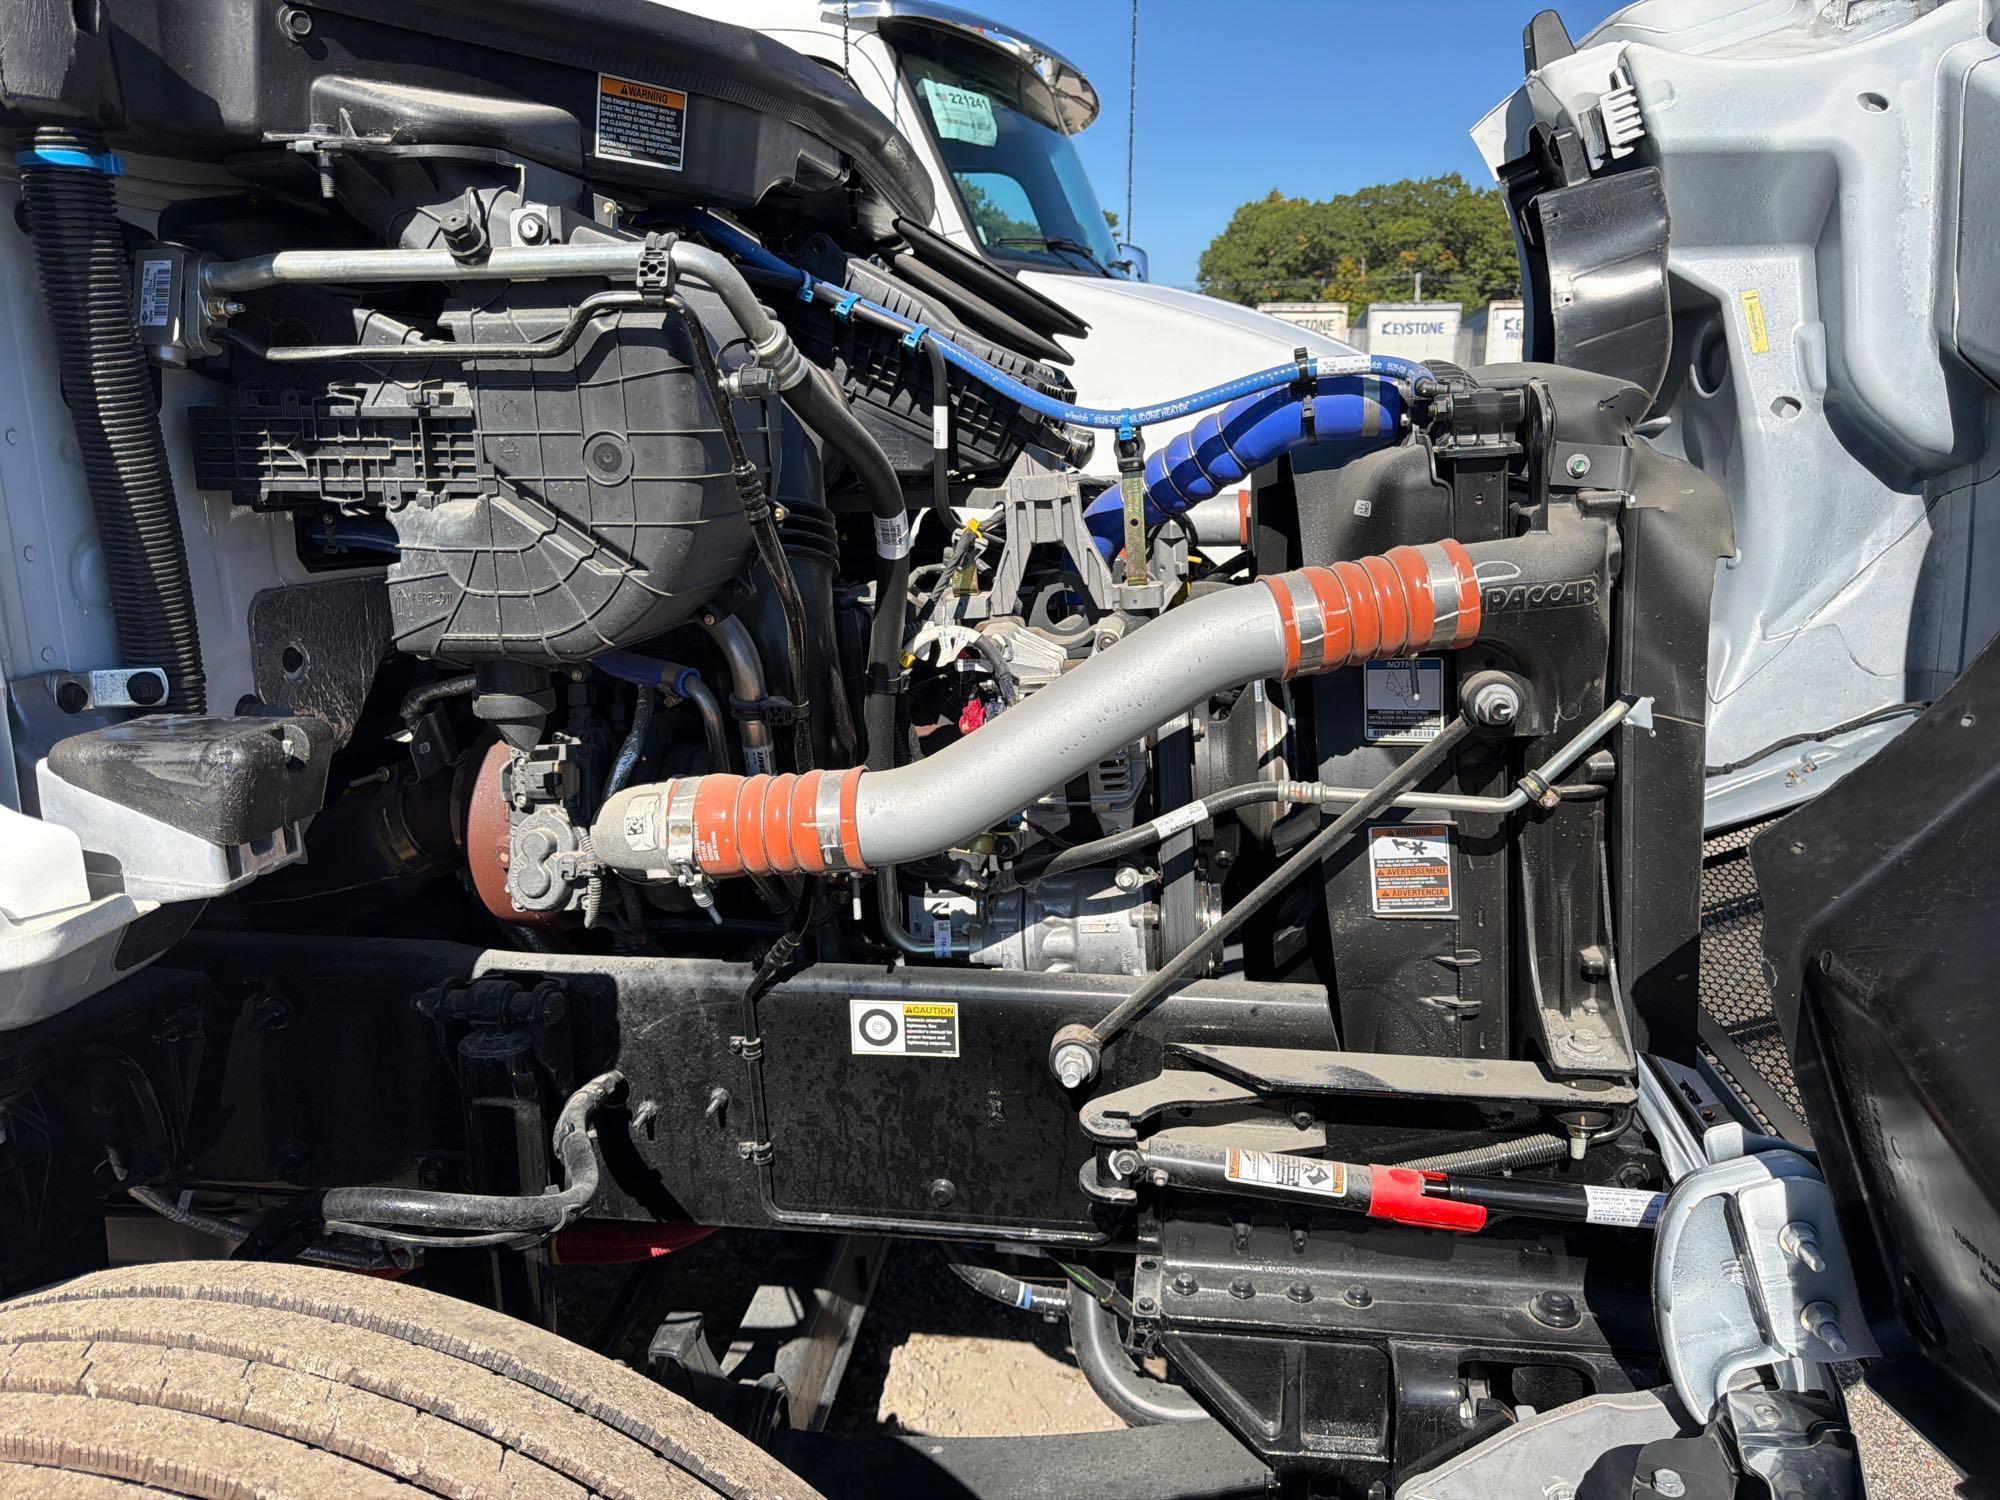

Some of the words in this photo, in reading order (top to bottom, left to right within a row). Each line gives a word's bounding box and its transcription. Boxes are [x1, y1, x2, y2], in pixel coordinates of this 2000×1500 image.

[628, 86, 668, 103] WARNING
[601, 103, 624, 113] ELECTRIC
[613, 98, 630, 107] ENGINE
[636, 102, 658, 112] EQUIPPED
[601, 110, 616, 119] SPRAY
[634, 117, 655, 126] STARTING
[610, 120, 631, 129] CLEANER
[650, 127, 664, 135] COULD
[665, 130, 680, 138] RESULT
[614, 128, 639, 138] EXPLOSION
[650, 134, 672, 143] PERSONAL
[600, 139, 626, 149] OPERATION
[1382, 322, 1446, 336] KEYSTONE
[1128, 410, 1160, 424] SILICONE
[1161, 403, 1189, 418] HEATER
[1486, 580, 1597, 613] PACCAR
[1396, 827, 1432, 836] WARNING
[1387, 867, 1446, 875] AVERTISSEMENT
[1952, 1226, 1980, 1259] TURN
